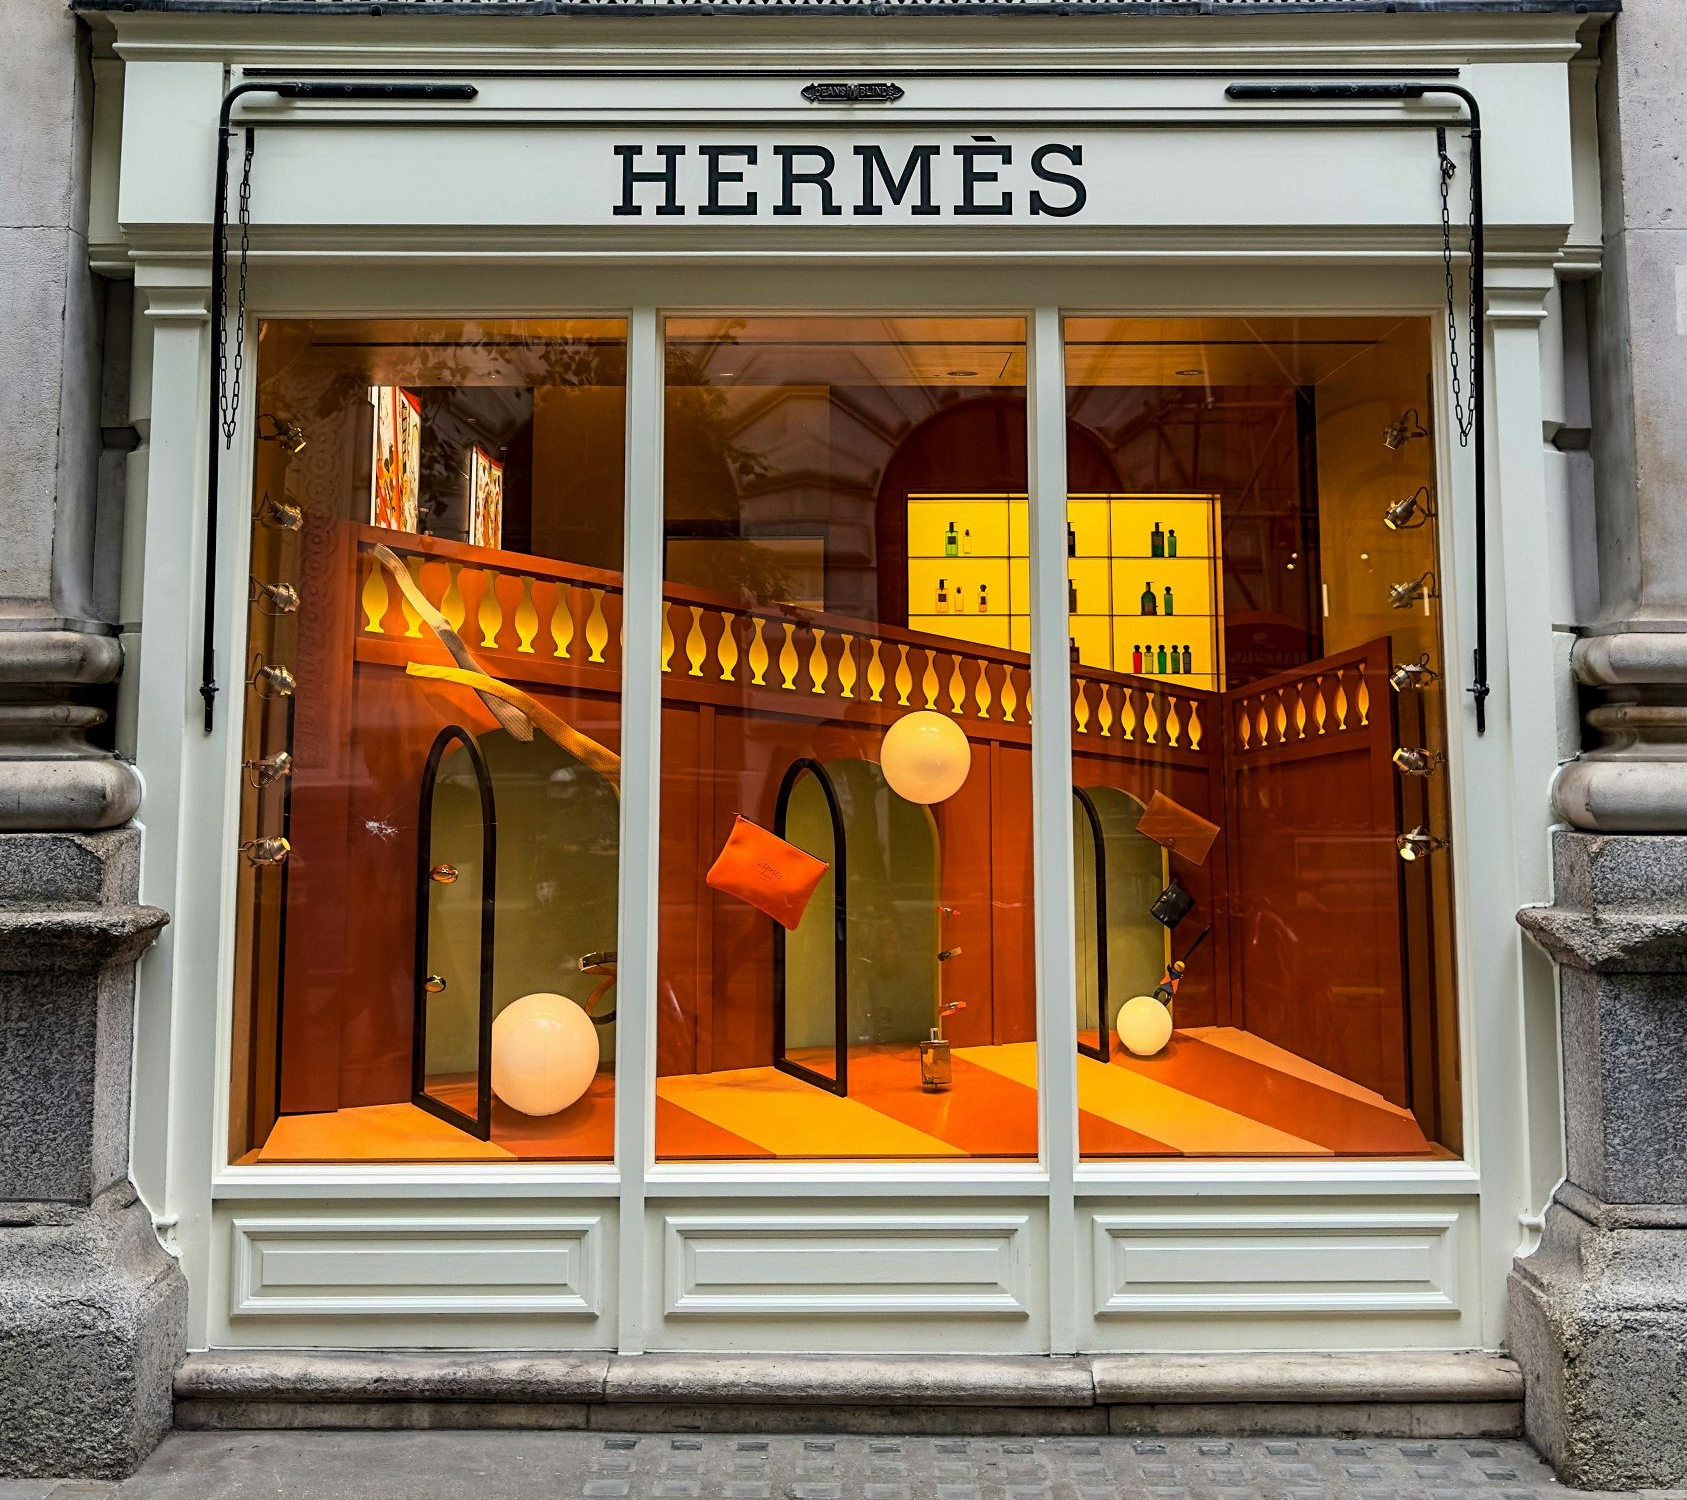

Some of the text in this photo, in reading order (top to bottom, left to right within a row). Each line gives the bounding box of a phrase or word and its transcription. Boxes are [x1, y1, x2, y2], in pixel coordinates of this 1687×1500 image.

[815, 86, 894, 96] DEANS BLINDS
[612, 135, 1087, 217] HERMÈS
